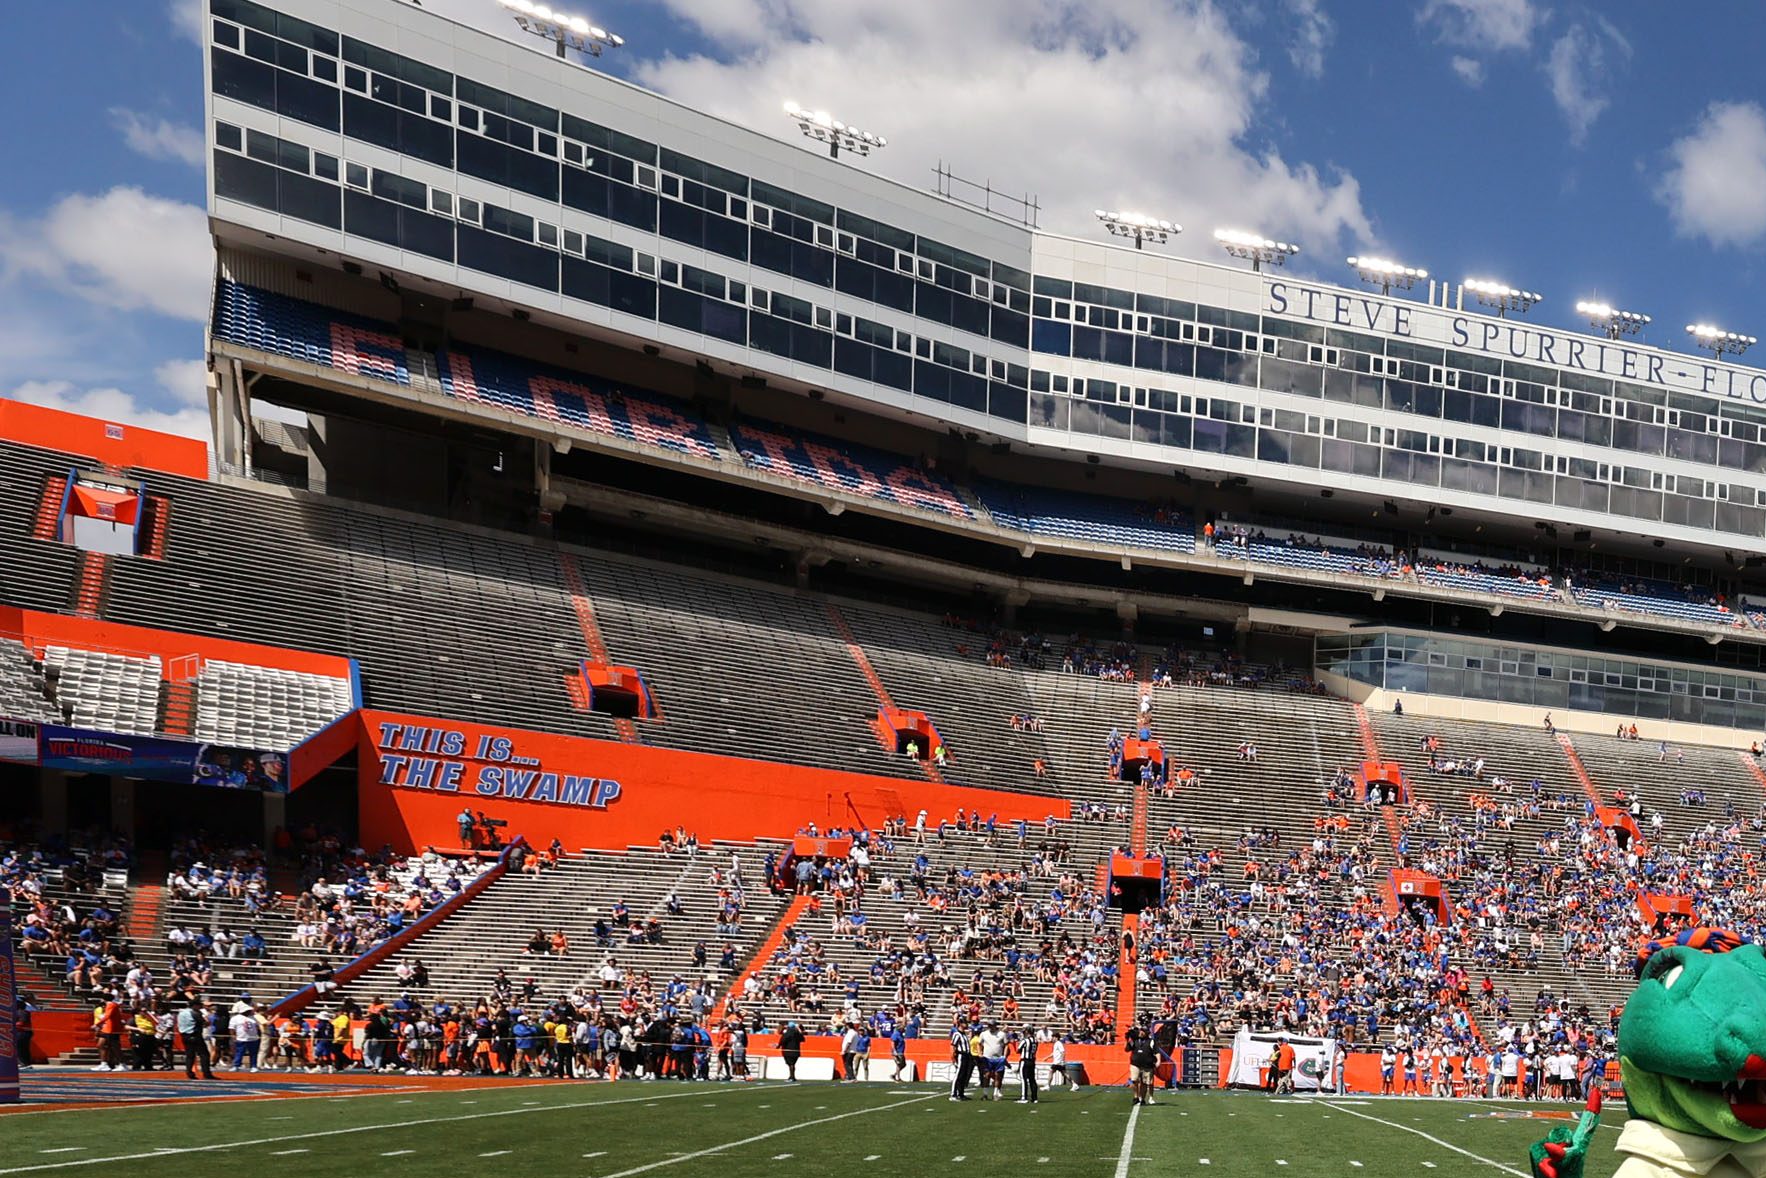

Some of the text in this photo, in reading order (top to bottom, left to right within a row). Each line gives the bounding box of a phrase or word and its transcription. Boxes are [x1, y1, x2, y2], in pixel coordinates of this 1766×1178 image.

[1270, 283, 1412, 337] STEVE
[48, 742, 133, 765] VICTORIOUS
[379, 722, 540, 766] THIS IS...
[378, 754, 622, 808] THE SWAMP
